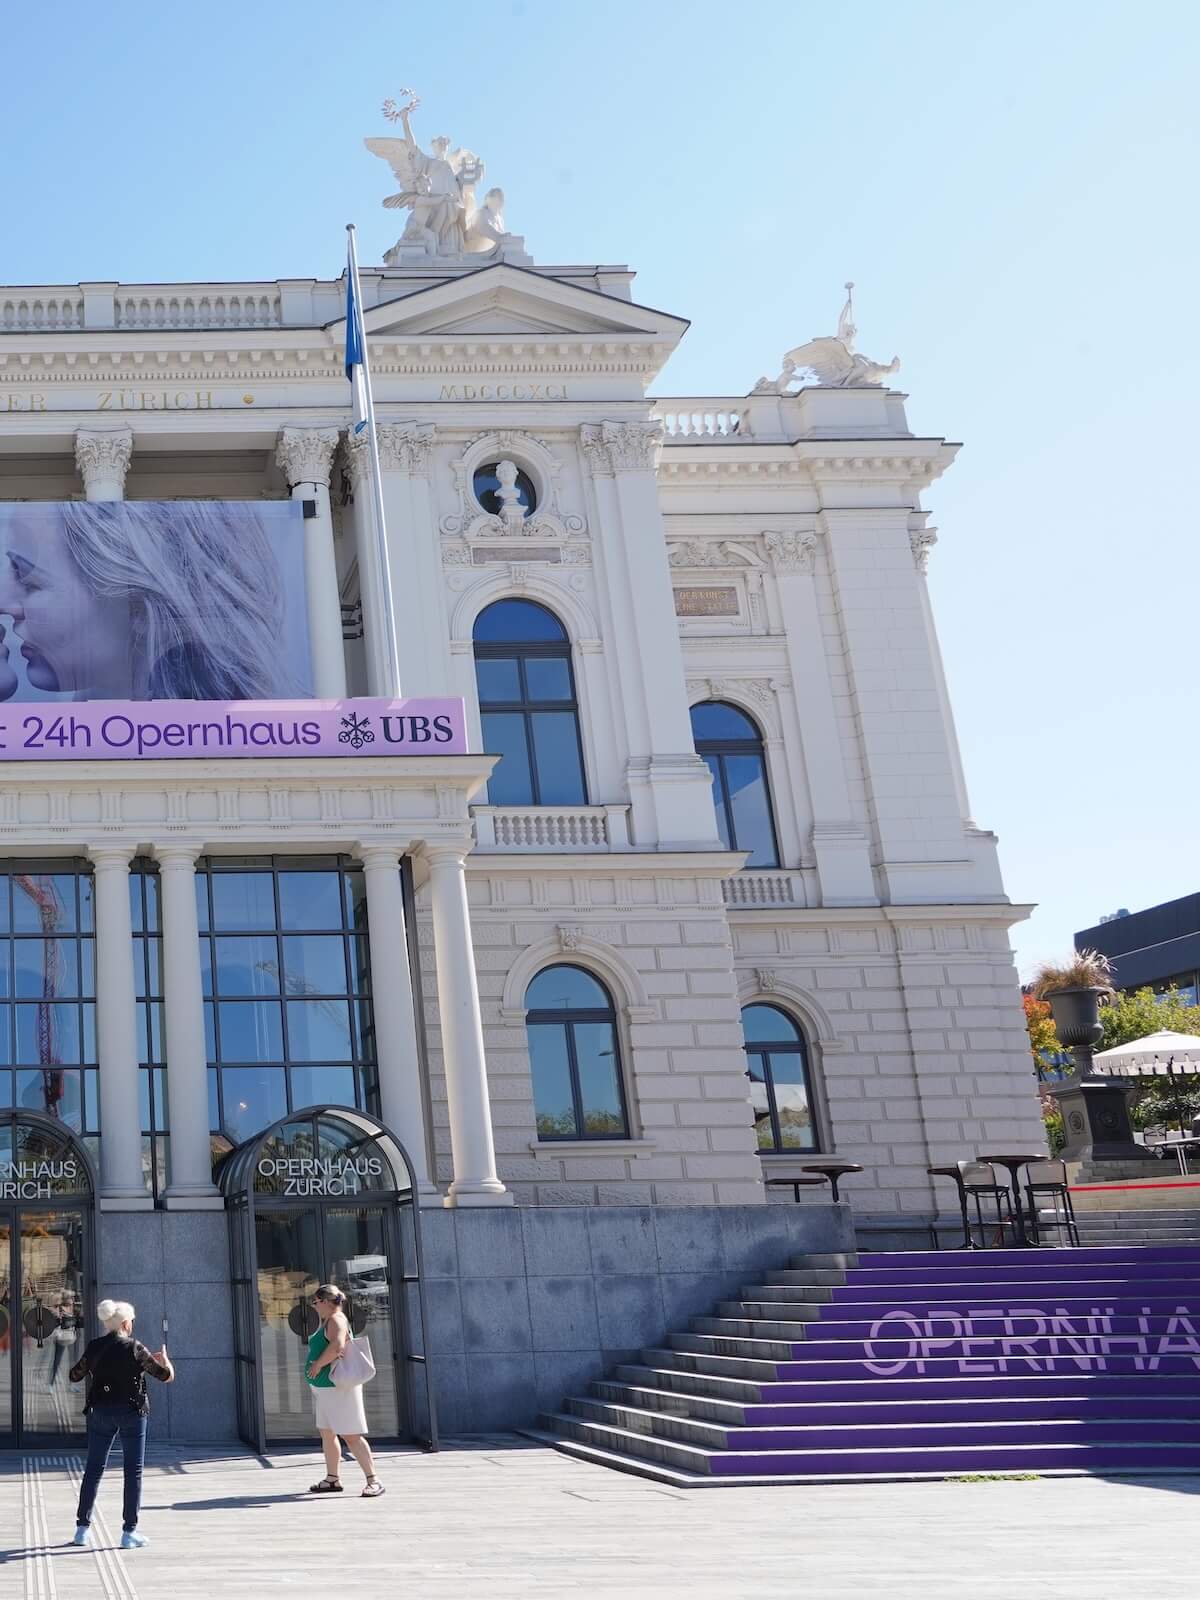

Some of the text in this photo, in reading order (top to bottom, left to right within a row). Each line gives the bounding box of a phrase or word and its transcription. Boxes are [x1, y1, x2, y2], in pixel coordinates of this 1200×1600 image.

[97, 389, 214, 410] ZÜRICH
[22, 716, 91, 748] 24h
[100, 714, 322, 755] Opernhaus
[379, 714, 454, 743] UBS
[257, 1157, 383, 1177] OPERNHAUS
[862, 1306, 1200, 1375] OPERNHA
